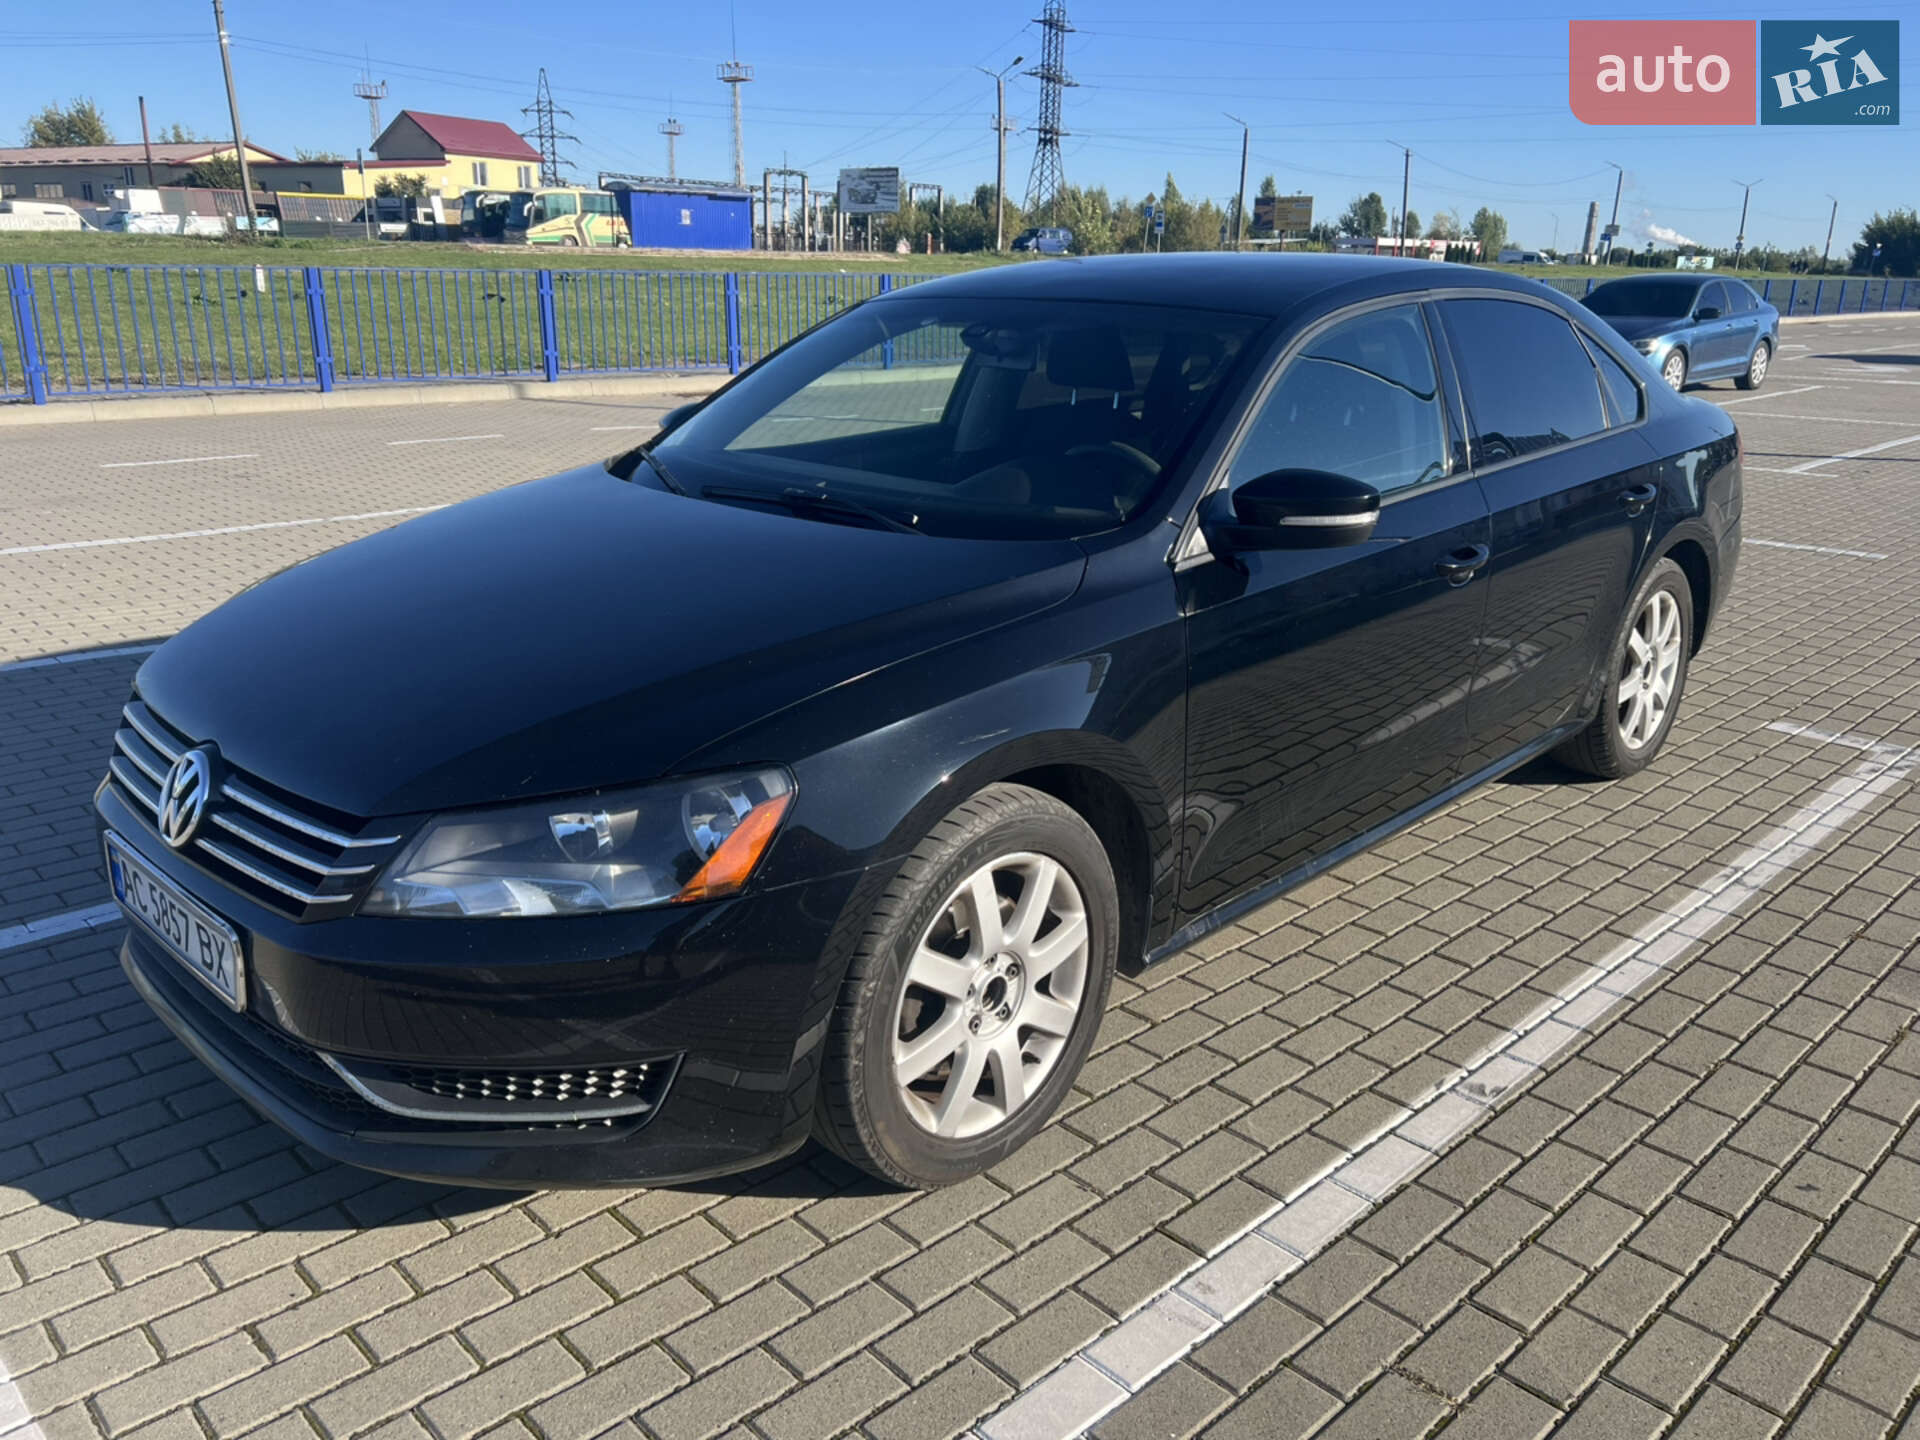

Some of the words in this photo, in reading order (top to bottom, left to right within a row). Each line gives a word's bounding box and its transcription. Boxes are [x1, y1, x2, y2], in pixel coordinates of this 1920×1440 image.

[121, 860, 148, 914] AC
[149, 886, 190, 953] 5857
[195, 921, 230, 989] BX
